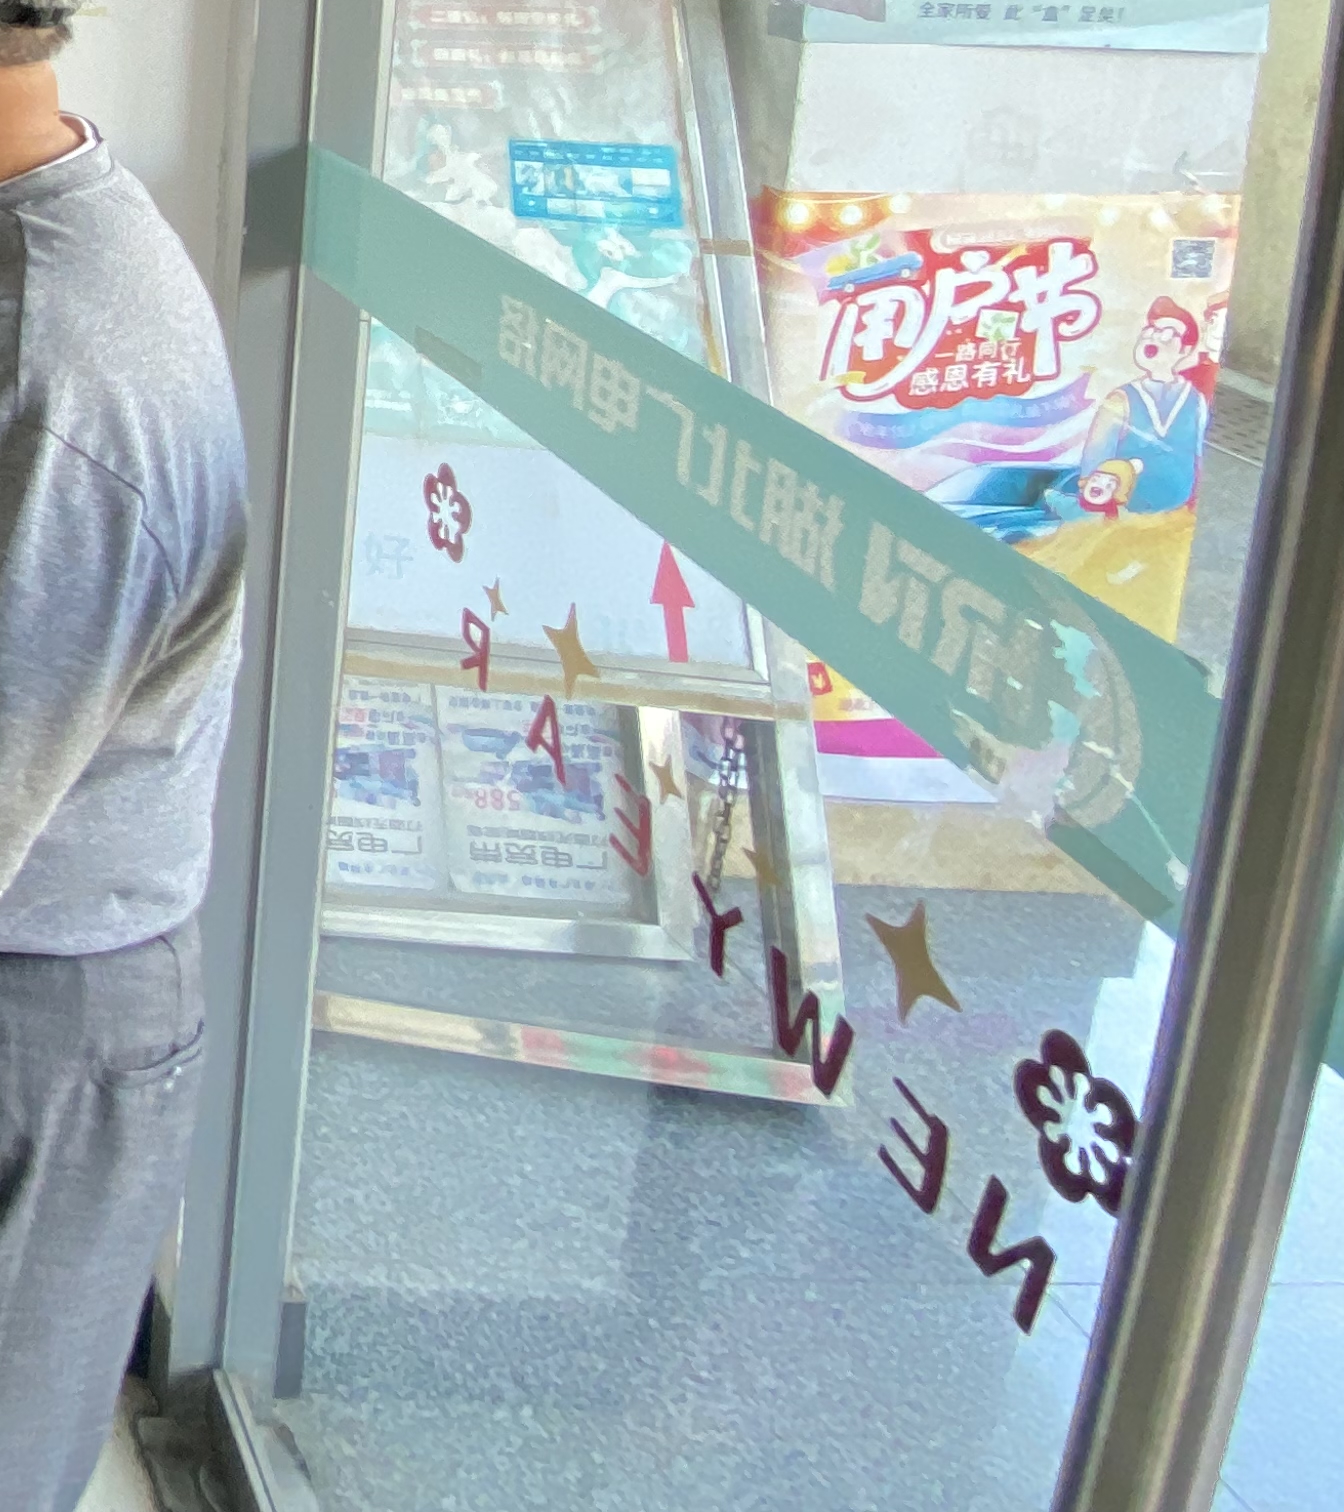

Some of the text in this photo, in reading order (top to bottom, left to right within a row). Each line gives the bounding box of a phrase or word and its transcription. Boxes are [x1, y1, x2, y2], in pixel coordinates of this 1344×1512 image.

[824, 238, 1102, 398] 用户节
[934, 338, 1023, 363] 一路同行
[909, 358, 1031, 396] 感恩有礼
[469, 840, 609, 870] 广电宽带
